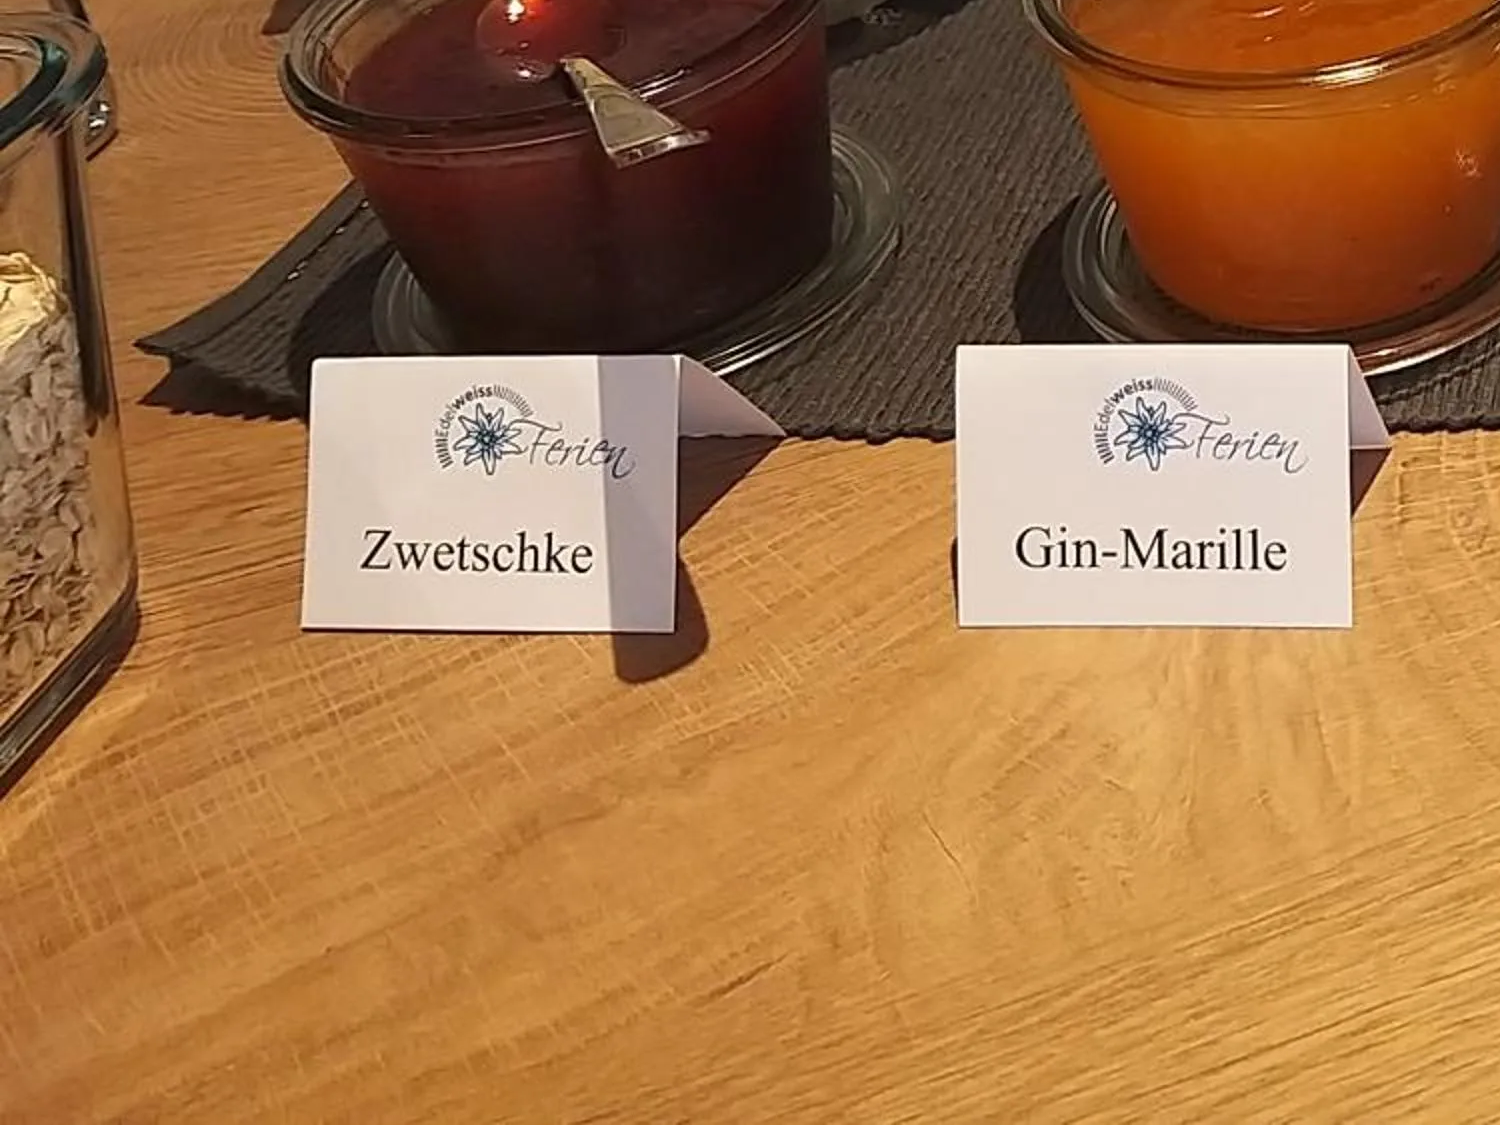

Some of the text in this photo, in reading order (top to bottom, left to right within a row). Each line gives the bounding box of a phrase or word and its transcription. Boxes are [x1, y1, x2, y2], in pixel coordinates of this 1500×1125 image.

[508, 418, 636, 480] Ferien
[1171, 412, 1309, 474] Ferien
[360, 529, 593, 574] Zwetschke
[1015, 526, 1287, 571] Gin-Marille
